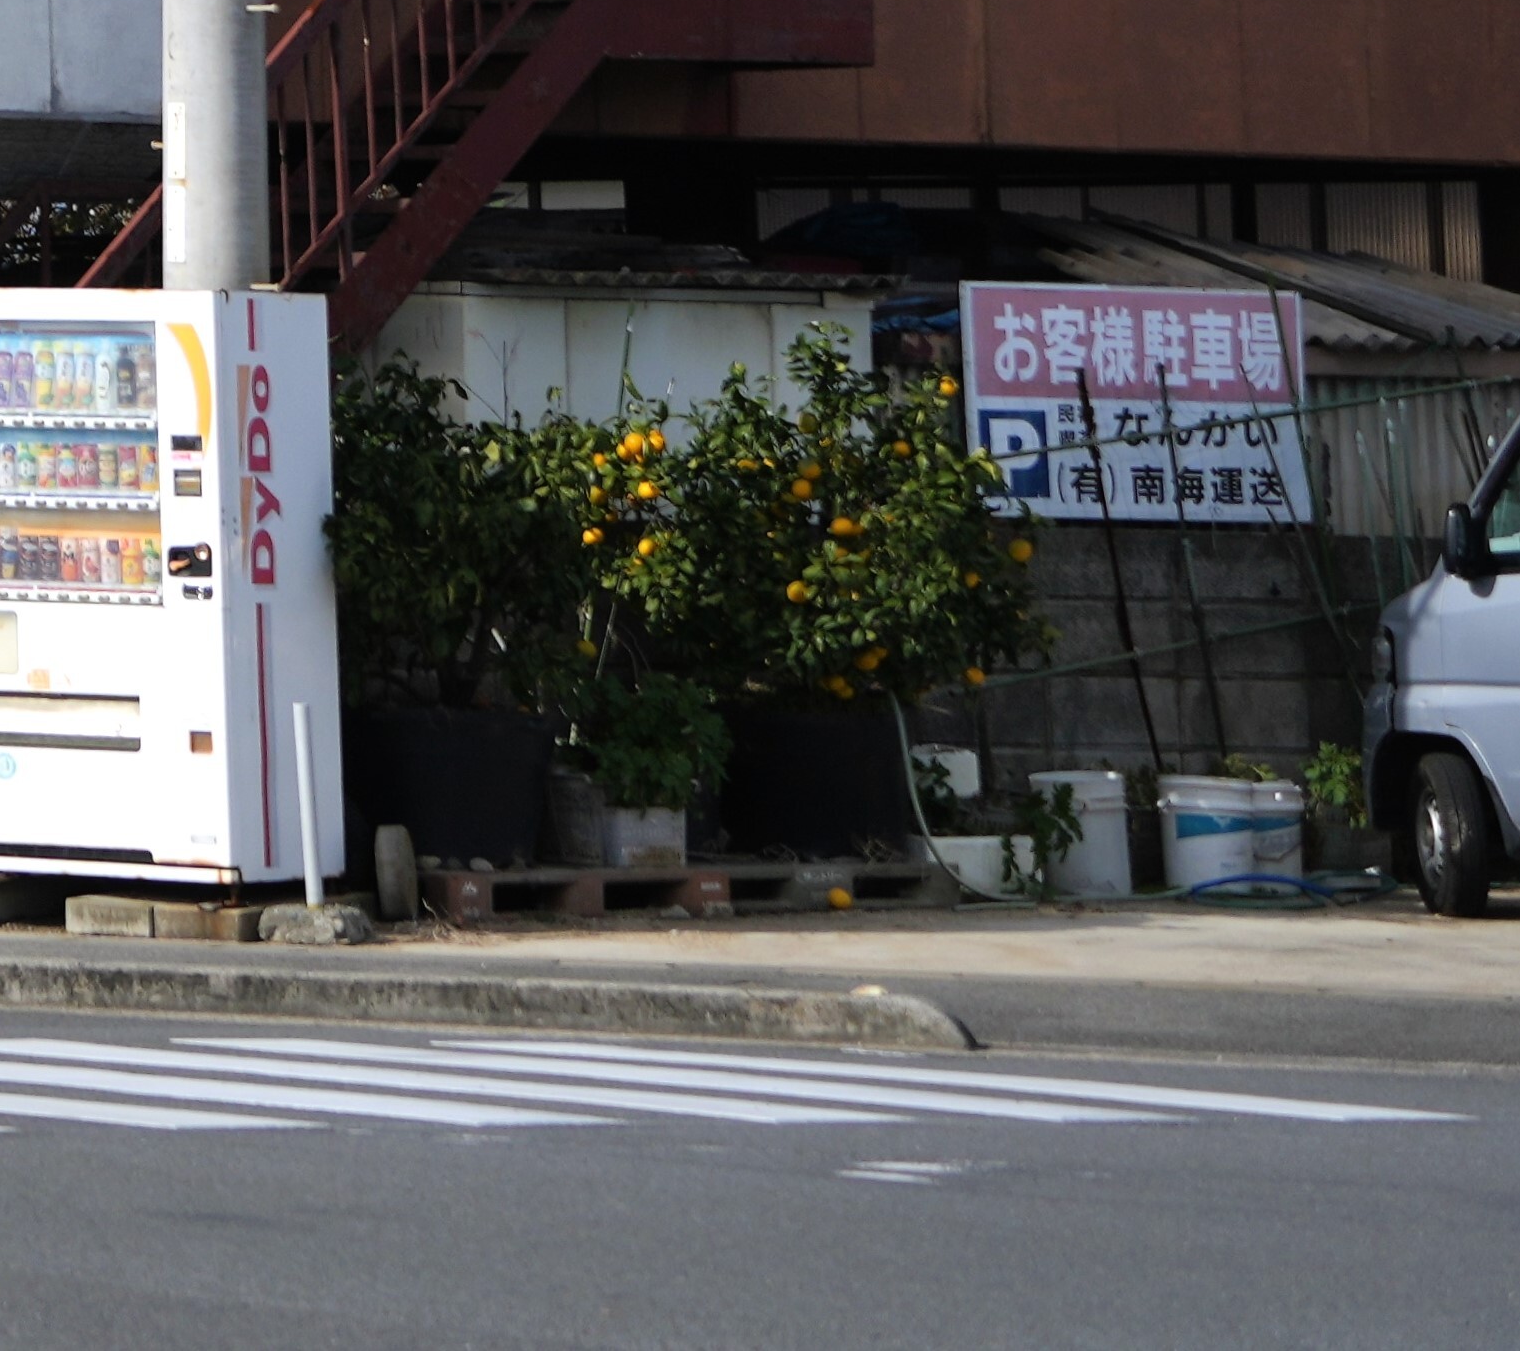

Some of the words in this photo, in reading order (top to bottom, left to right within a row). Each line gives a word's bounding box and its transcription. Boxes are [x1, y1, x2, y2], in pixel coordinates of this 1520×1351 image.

[993, 302, 1281, 391] お客様駐車場
[988, 417, 1040, 498] P
[1114, 407, 1278, 447] なんかい
[1130, 464, 1284, 505] 南海運送
